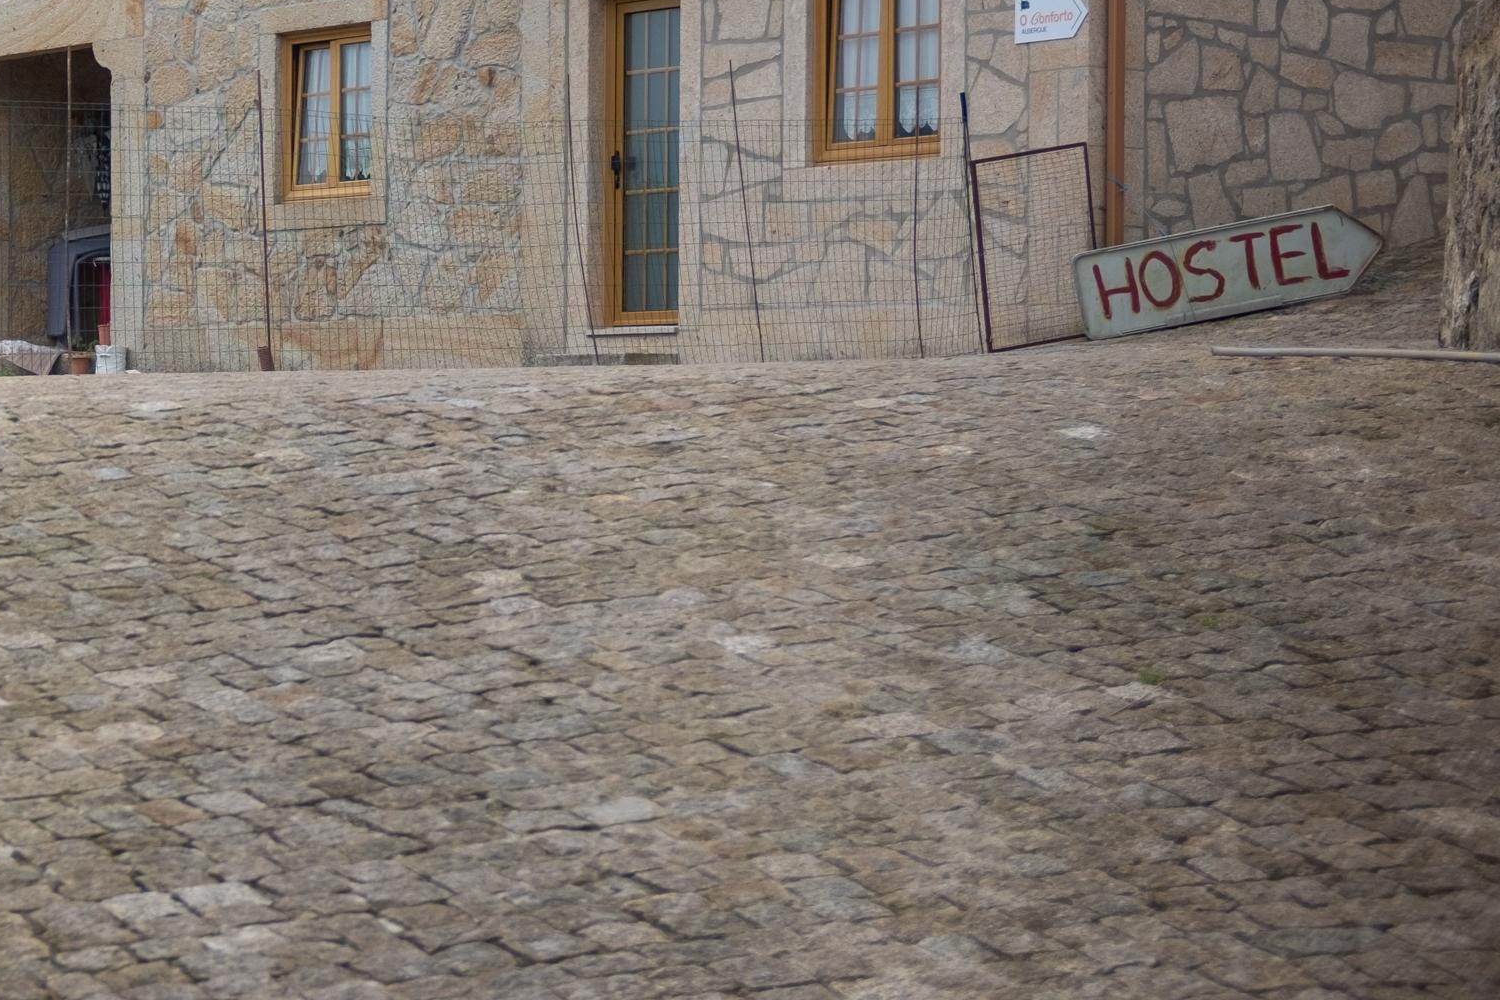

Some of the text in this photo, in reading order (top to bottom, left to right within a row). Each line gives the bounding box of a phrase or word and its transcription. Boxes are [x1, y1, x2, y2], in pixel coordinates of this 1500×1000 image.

[1020, 9, 1074, 26] O Conforto
[1092, 221, 1350, 320] HOSTEL
